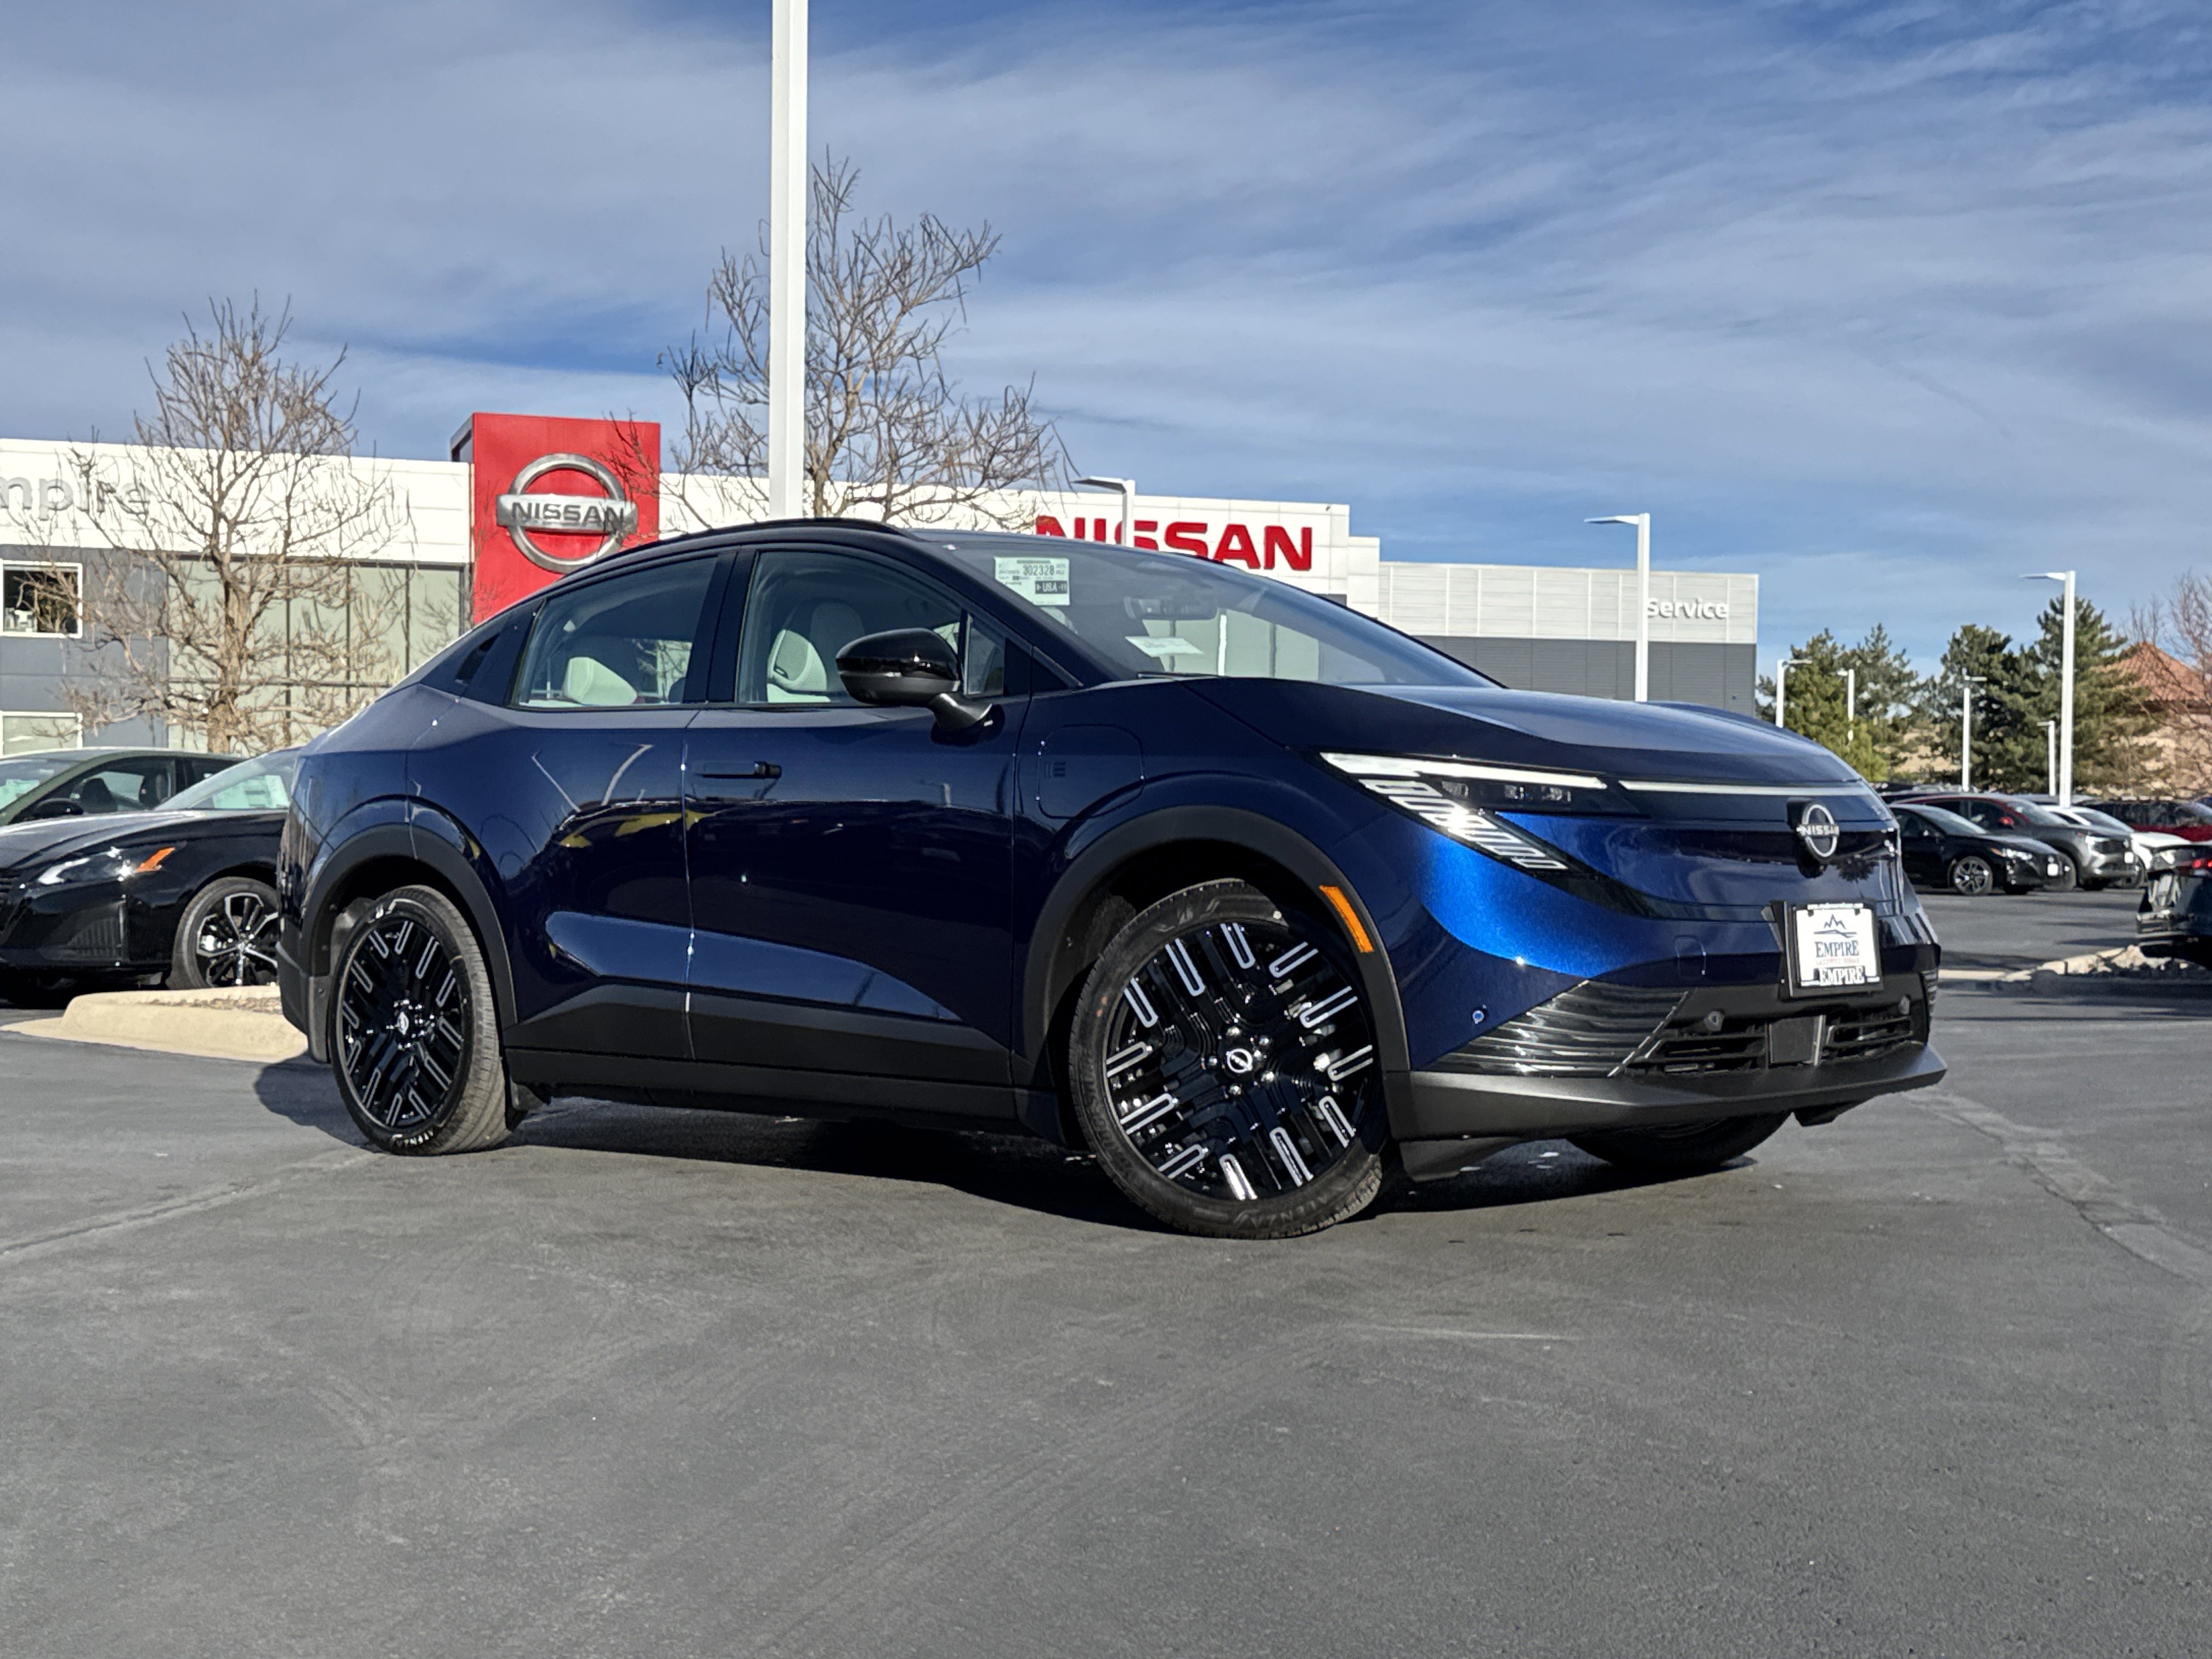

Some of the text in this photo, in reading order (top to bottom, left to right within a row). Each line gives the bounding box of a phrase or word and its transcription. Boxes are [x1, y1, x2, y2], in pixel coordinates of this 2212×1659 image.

[511, 501, 625, 526] NISSAN
[1646, 597, 1729, 619] Service
[1814, 940, 1860, 958] EMPIRE
[1820, 966, 1865, 986] EMPIRE
